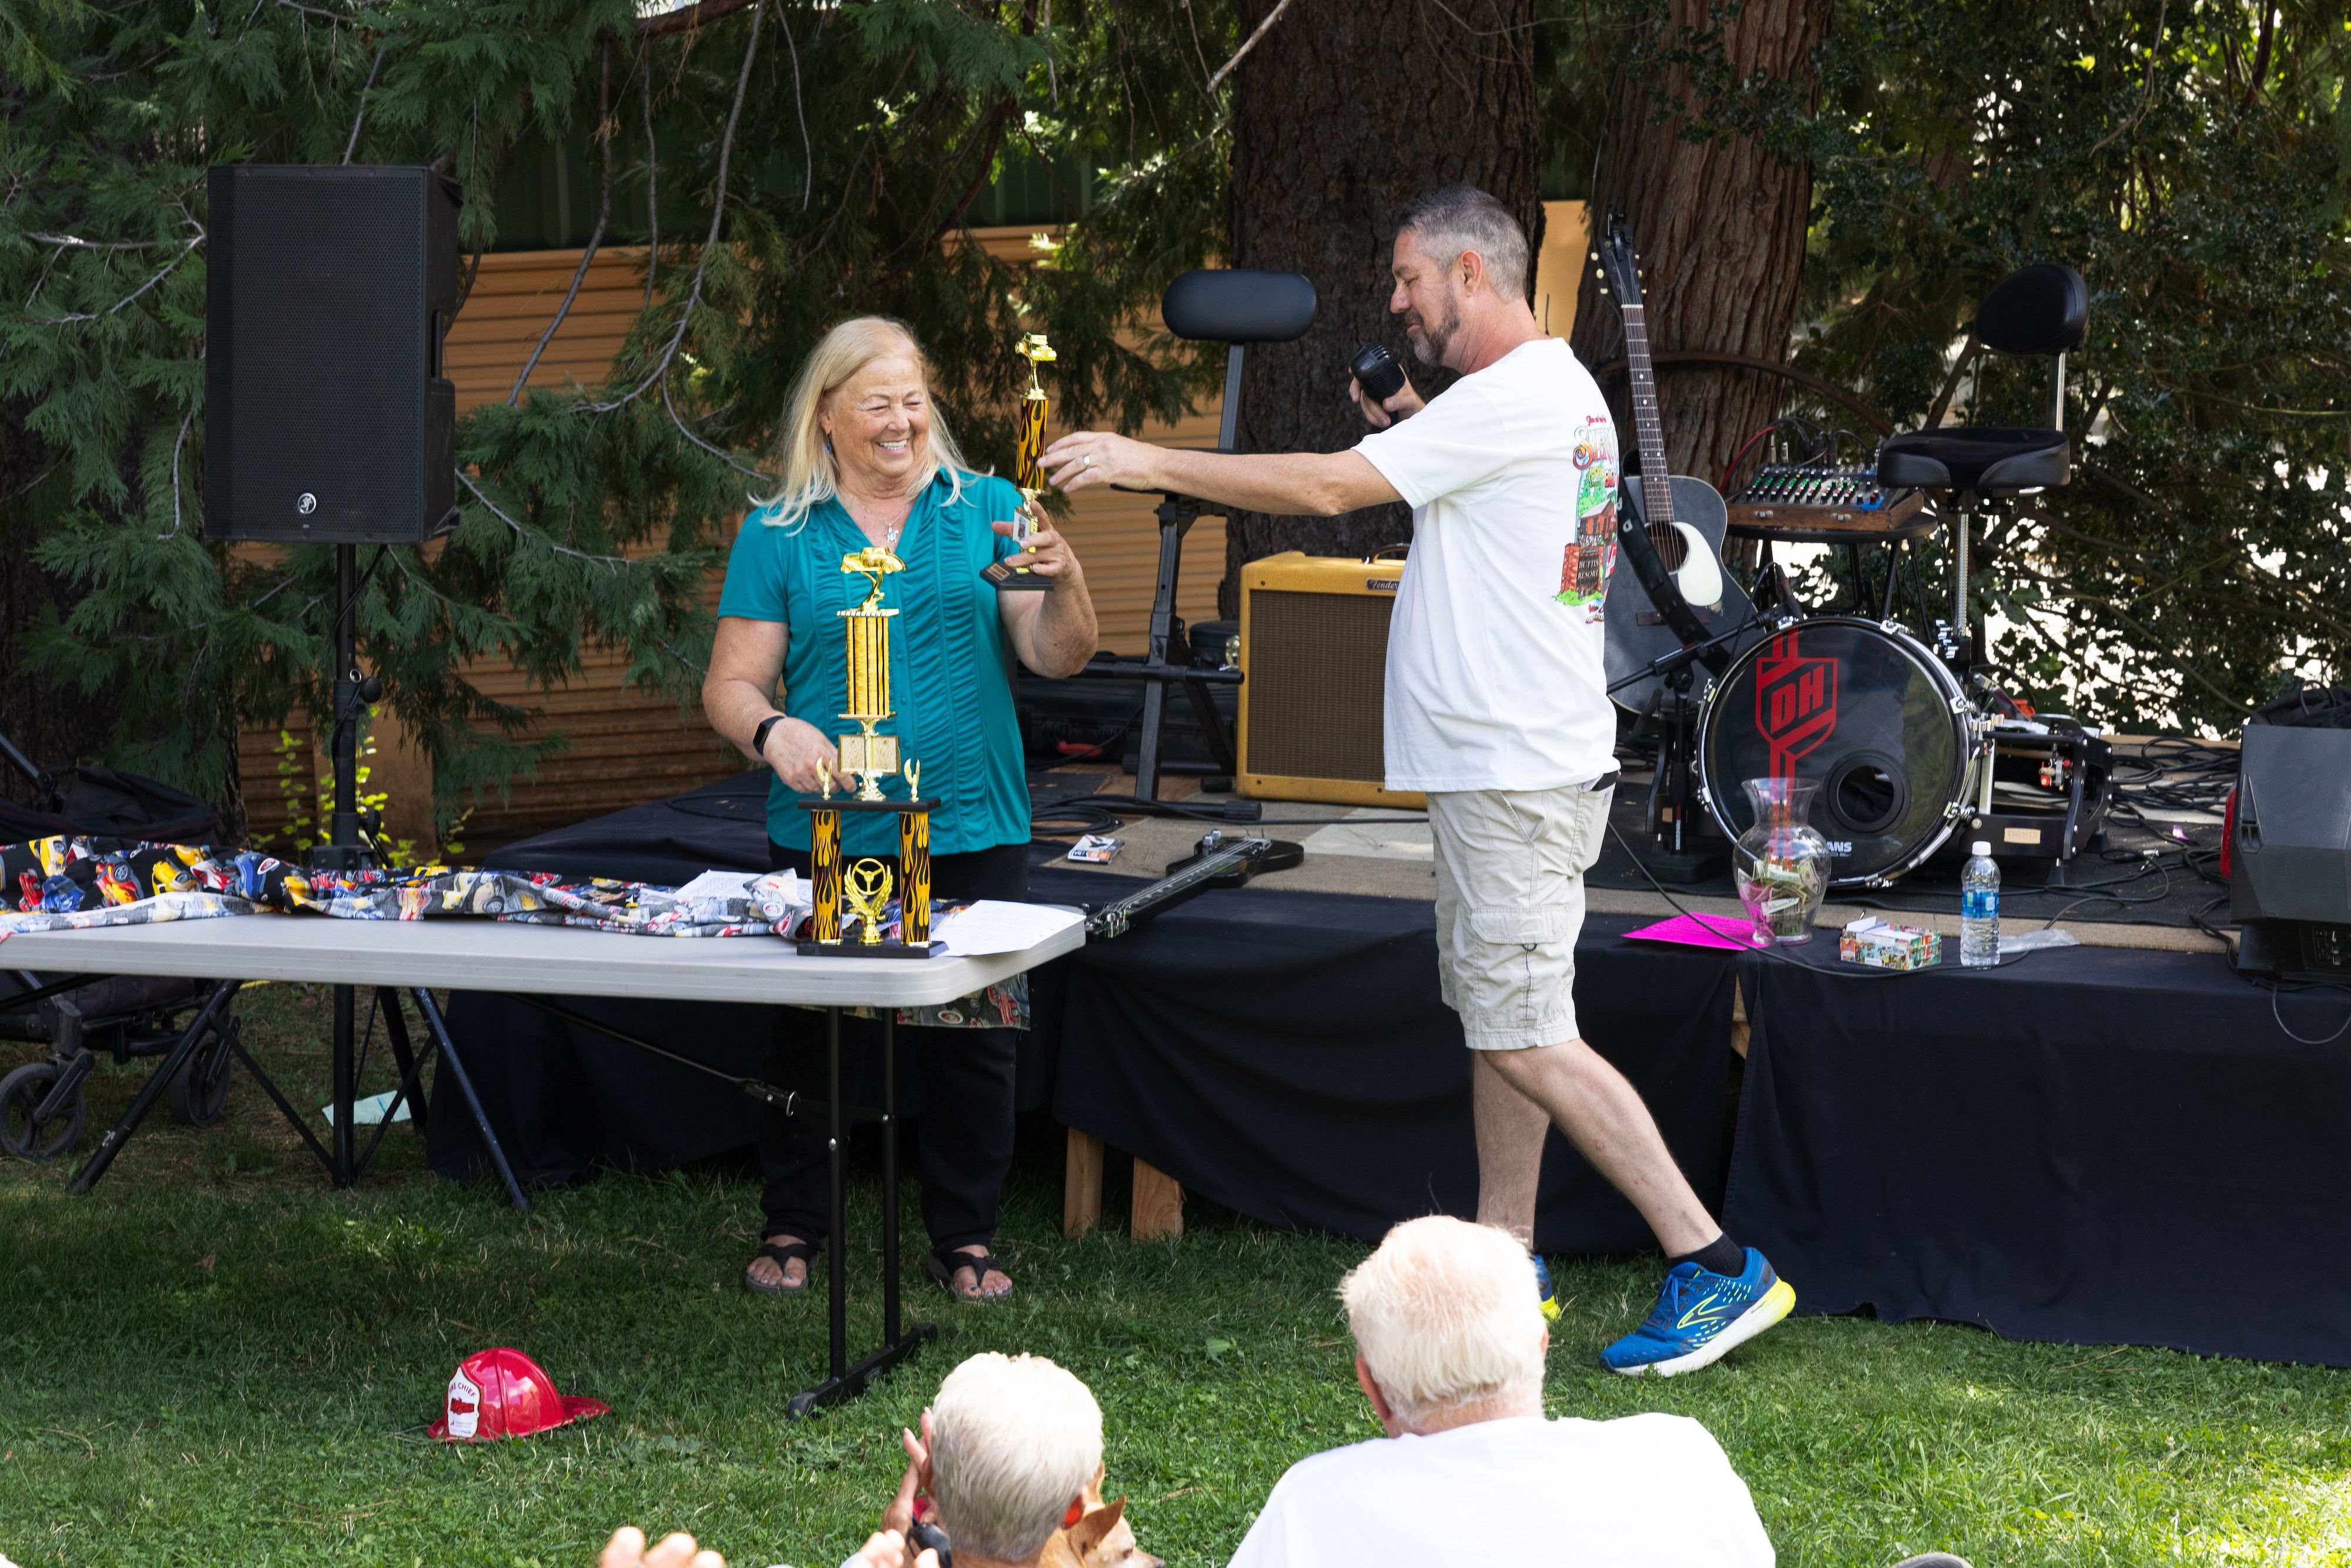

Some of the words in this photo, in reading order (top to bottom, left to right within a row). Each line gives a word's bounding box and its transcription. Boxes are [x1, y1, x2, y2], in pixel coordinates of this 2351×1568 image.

[1578, 569, 1598, 579] RESORT
[1370, 580, 1399, 589] Fender
[1770, 664, 1824, 734] DH
[458, 1382, 475, 1397] CHIEF
